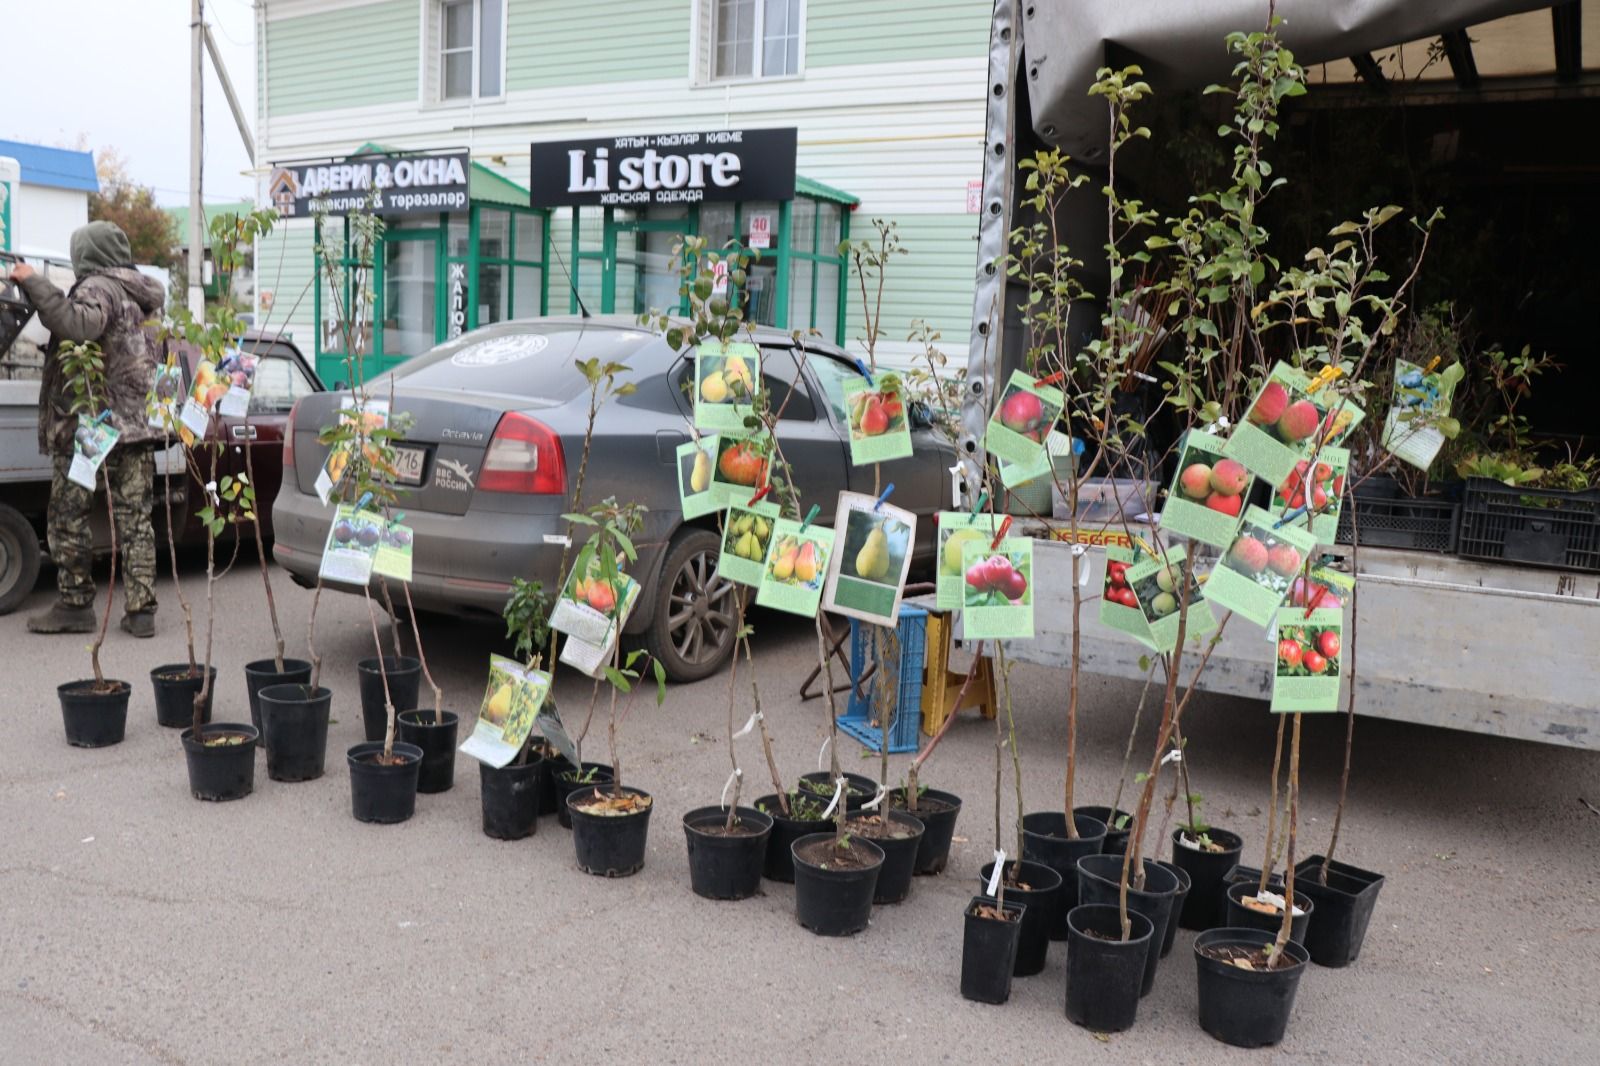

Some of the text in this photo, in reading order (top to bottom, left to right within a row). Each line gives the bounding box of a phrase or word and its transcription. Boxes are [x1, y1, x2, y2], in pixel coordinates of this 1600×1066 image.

[706, 130, 743, 145] КИЕМЕ
[302, 157, 467, 197] ДВЕРИ & ОКНА
[567, 147, 742, 192] Li store
[600, 188, 703, 205] ЖЕНСКАЯ ОДЕЖДА
[752, 217, 768, 231] 40
[436, 467, 452, 478] ВВС
[435, 478, 467, 492] РОССИИ
